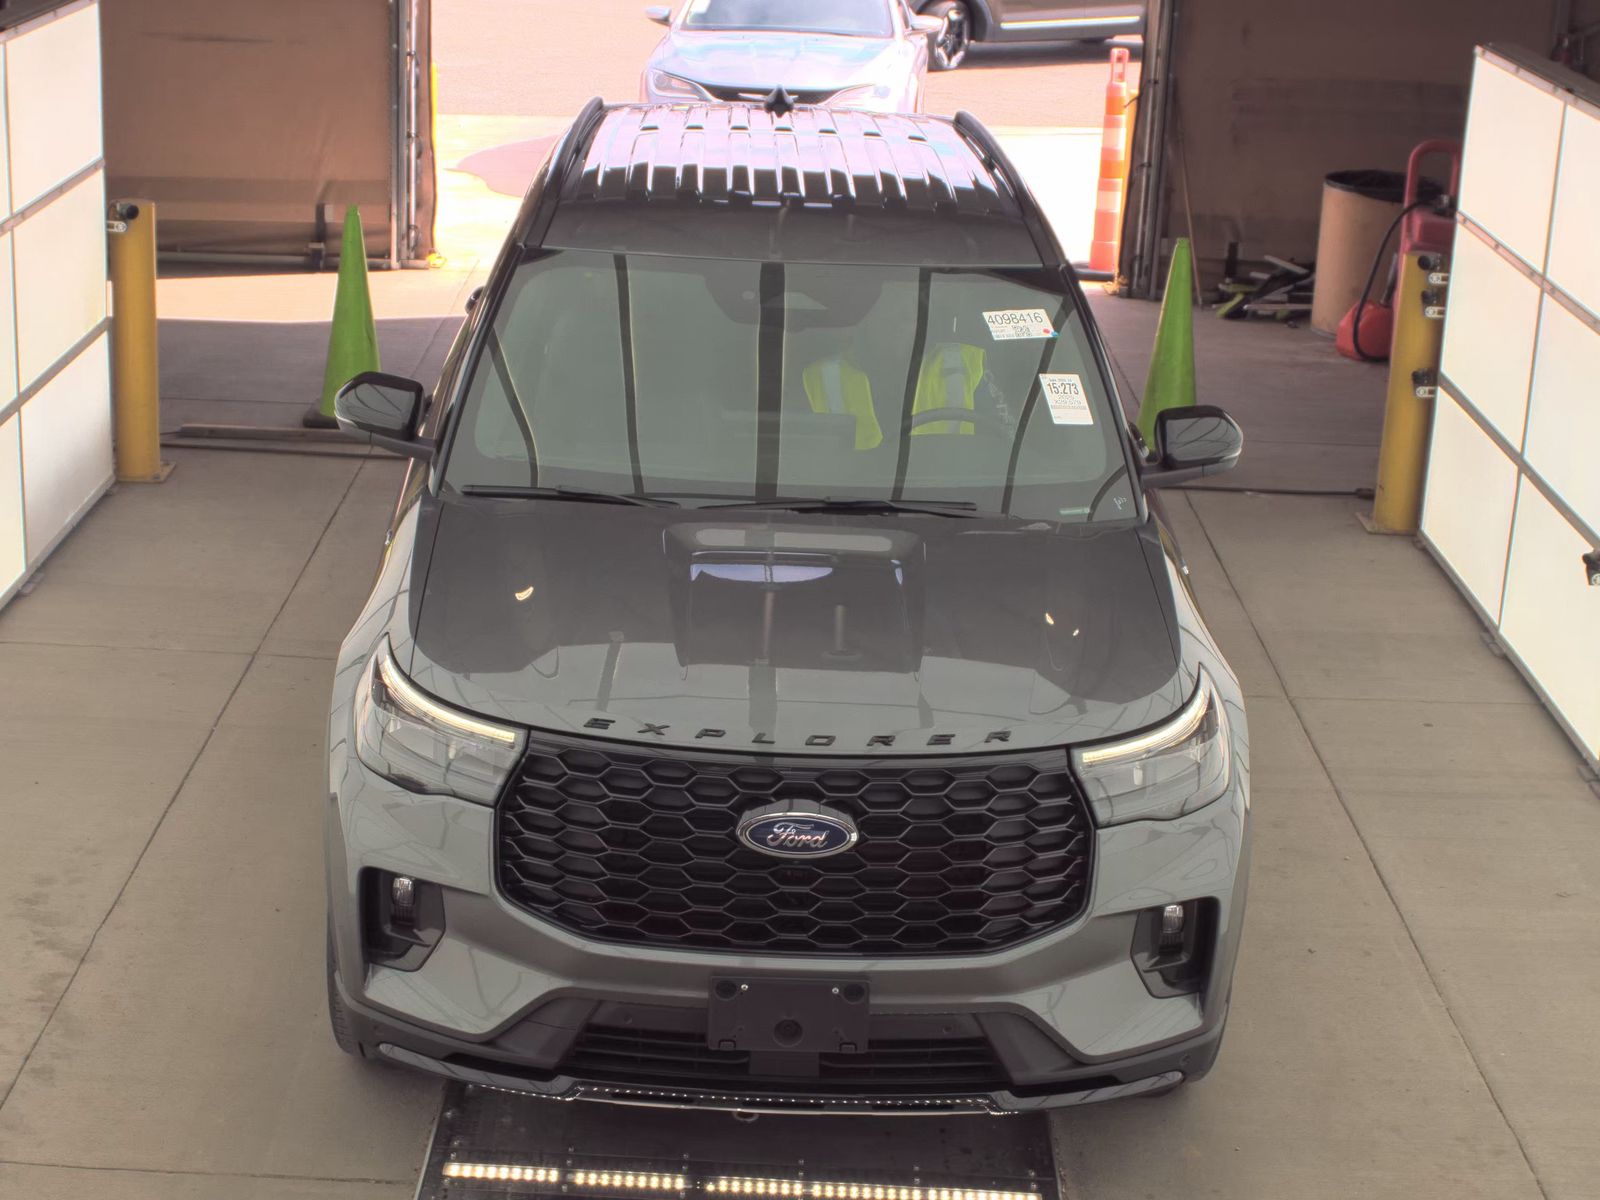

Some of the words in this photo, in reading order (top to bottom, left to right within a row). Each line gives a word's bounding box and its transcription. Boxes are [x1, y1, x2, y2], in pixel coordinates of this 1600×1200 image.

[988, 312, 1043, 325] 4098416
[583, 717, 1012, 747] EXPLORER
[767, 822, 829, 849] Ford
